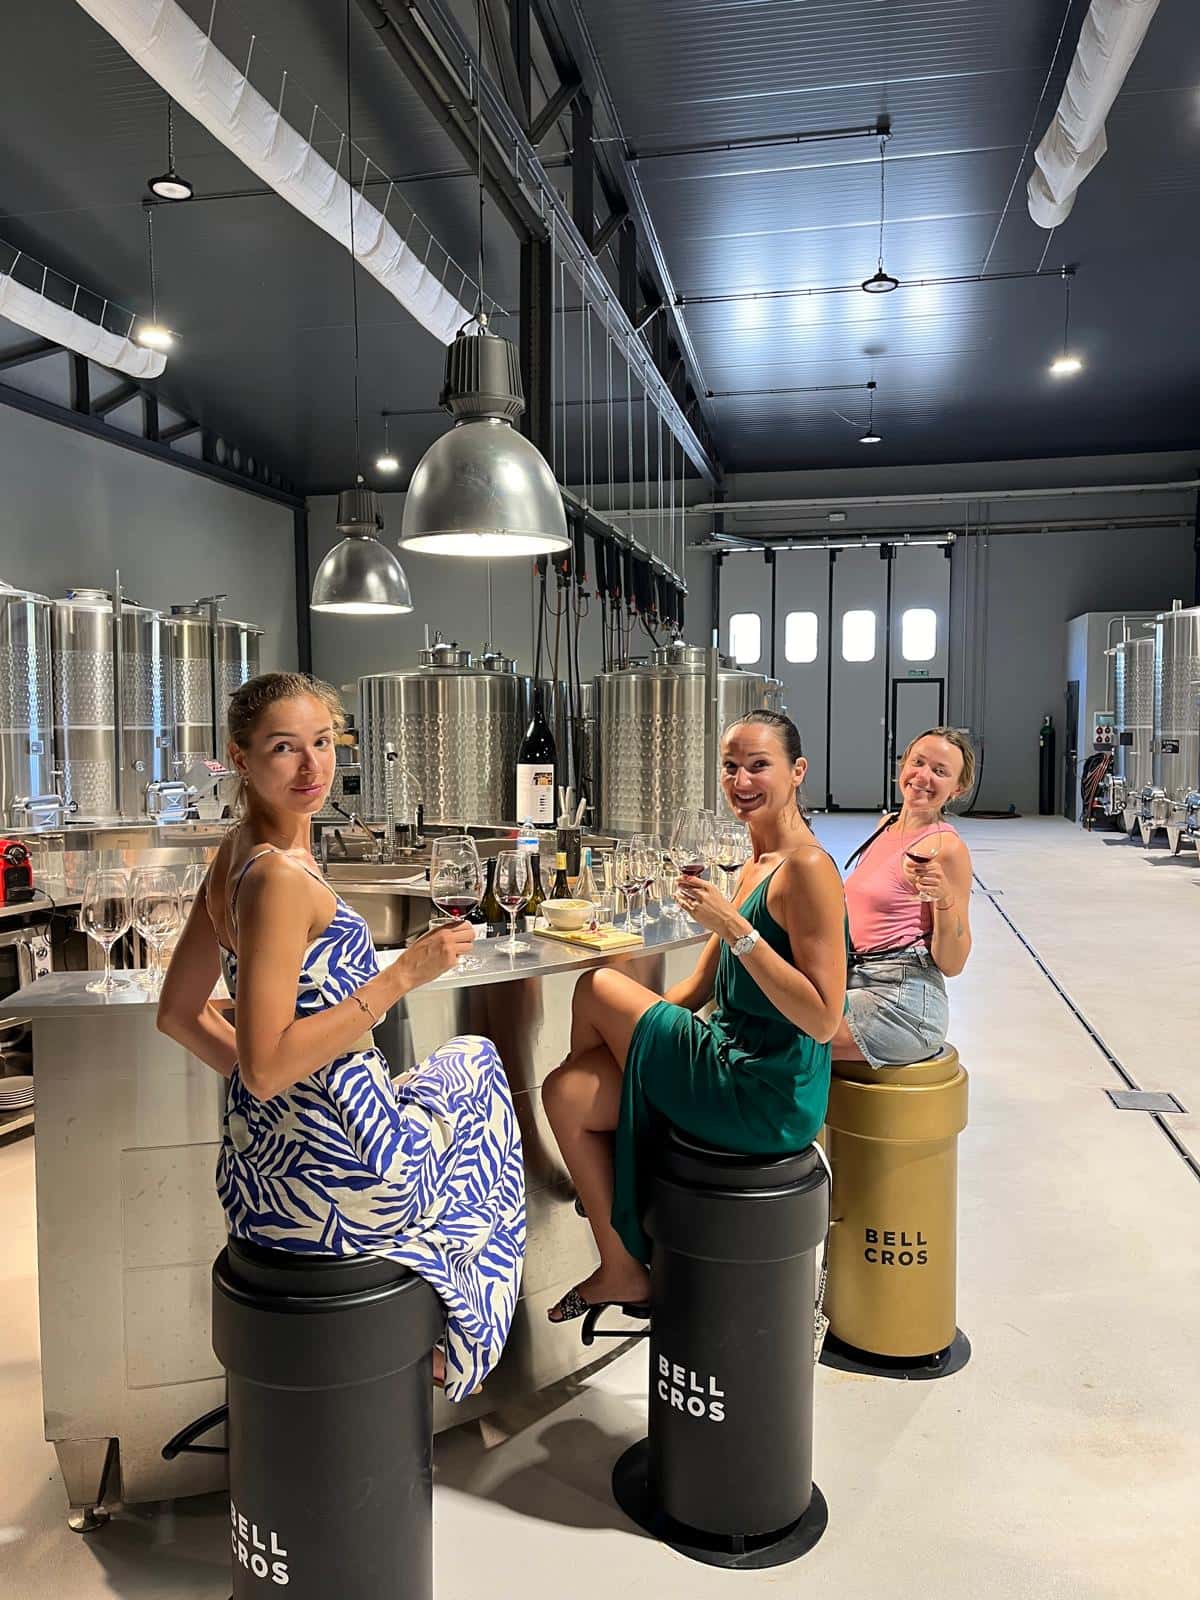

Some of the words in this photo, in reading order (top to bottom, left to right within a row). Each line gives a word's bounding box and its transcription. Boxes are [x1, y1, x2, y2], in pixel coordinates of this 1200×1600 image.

[864, 1247, 928, 1266] CROS
[865, 1228, 927, 1246] BELL
[659, 1353, 725, 1397] BELL
[658, 1379, 725, 1422] CROS
[231, 1499, 288, 1557] BELL
[231, 1529, 290, 1585] CROS
